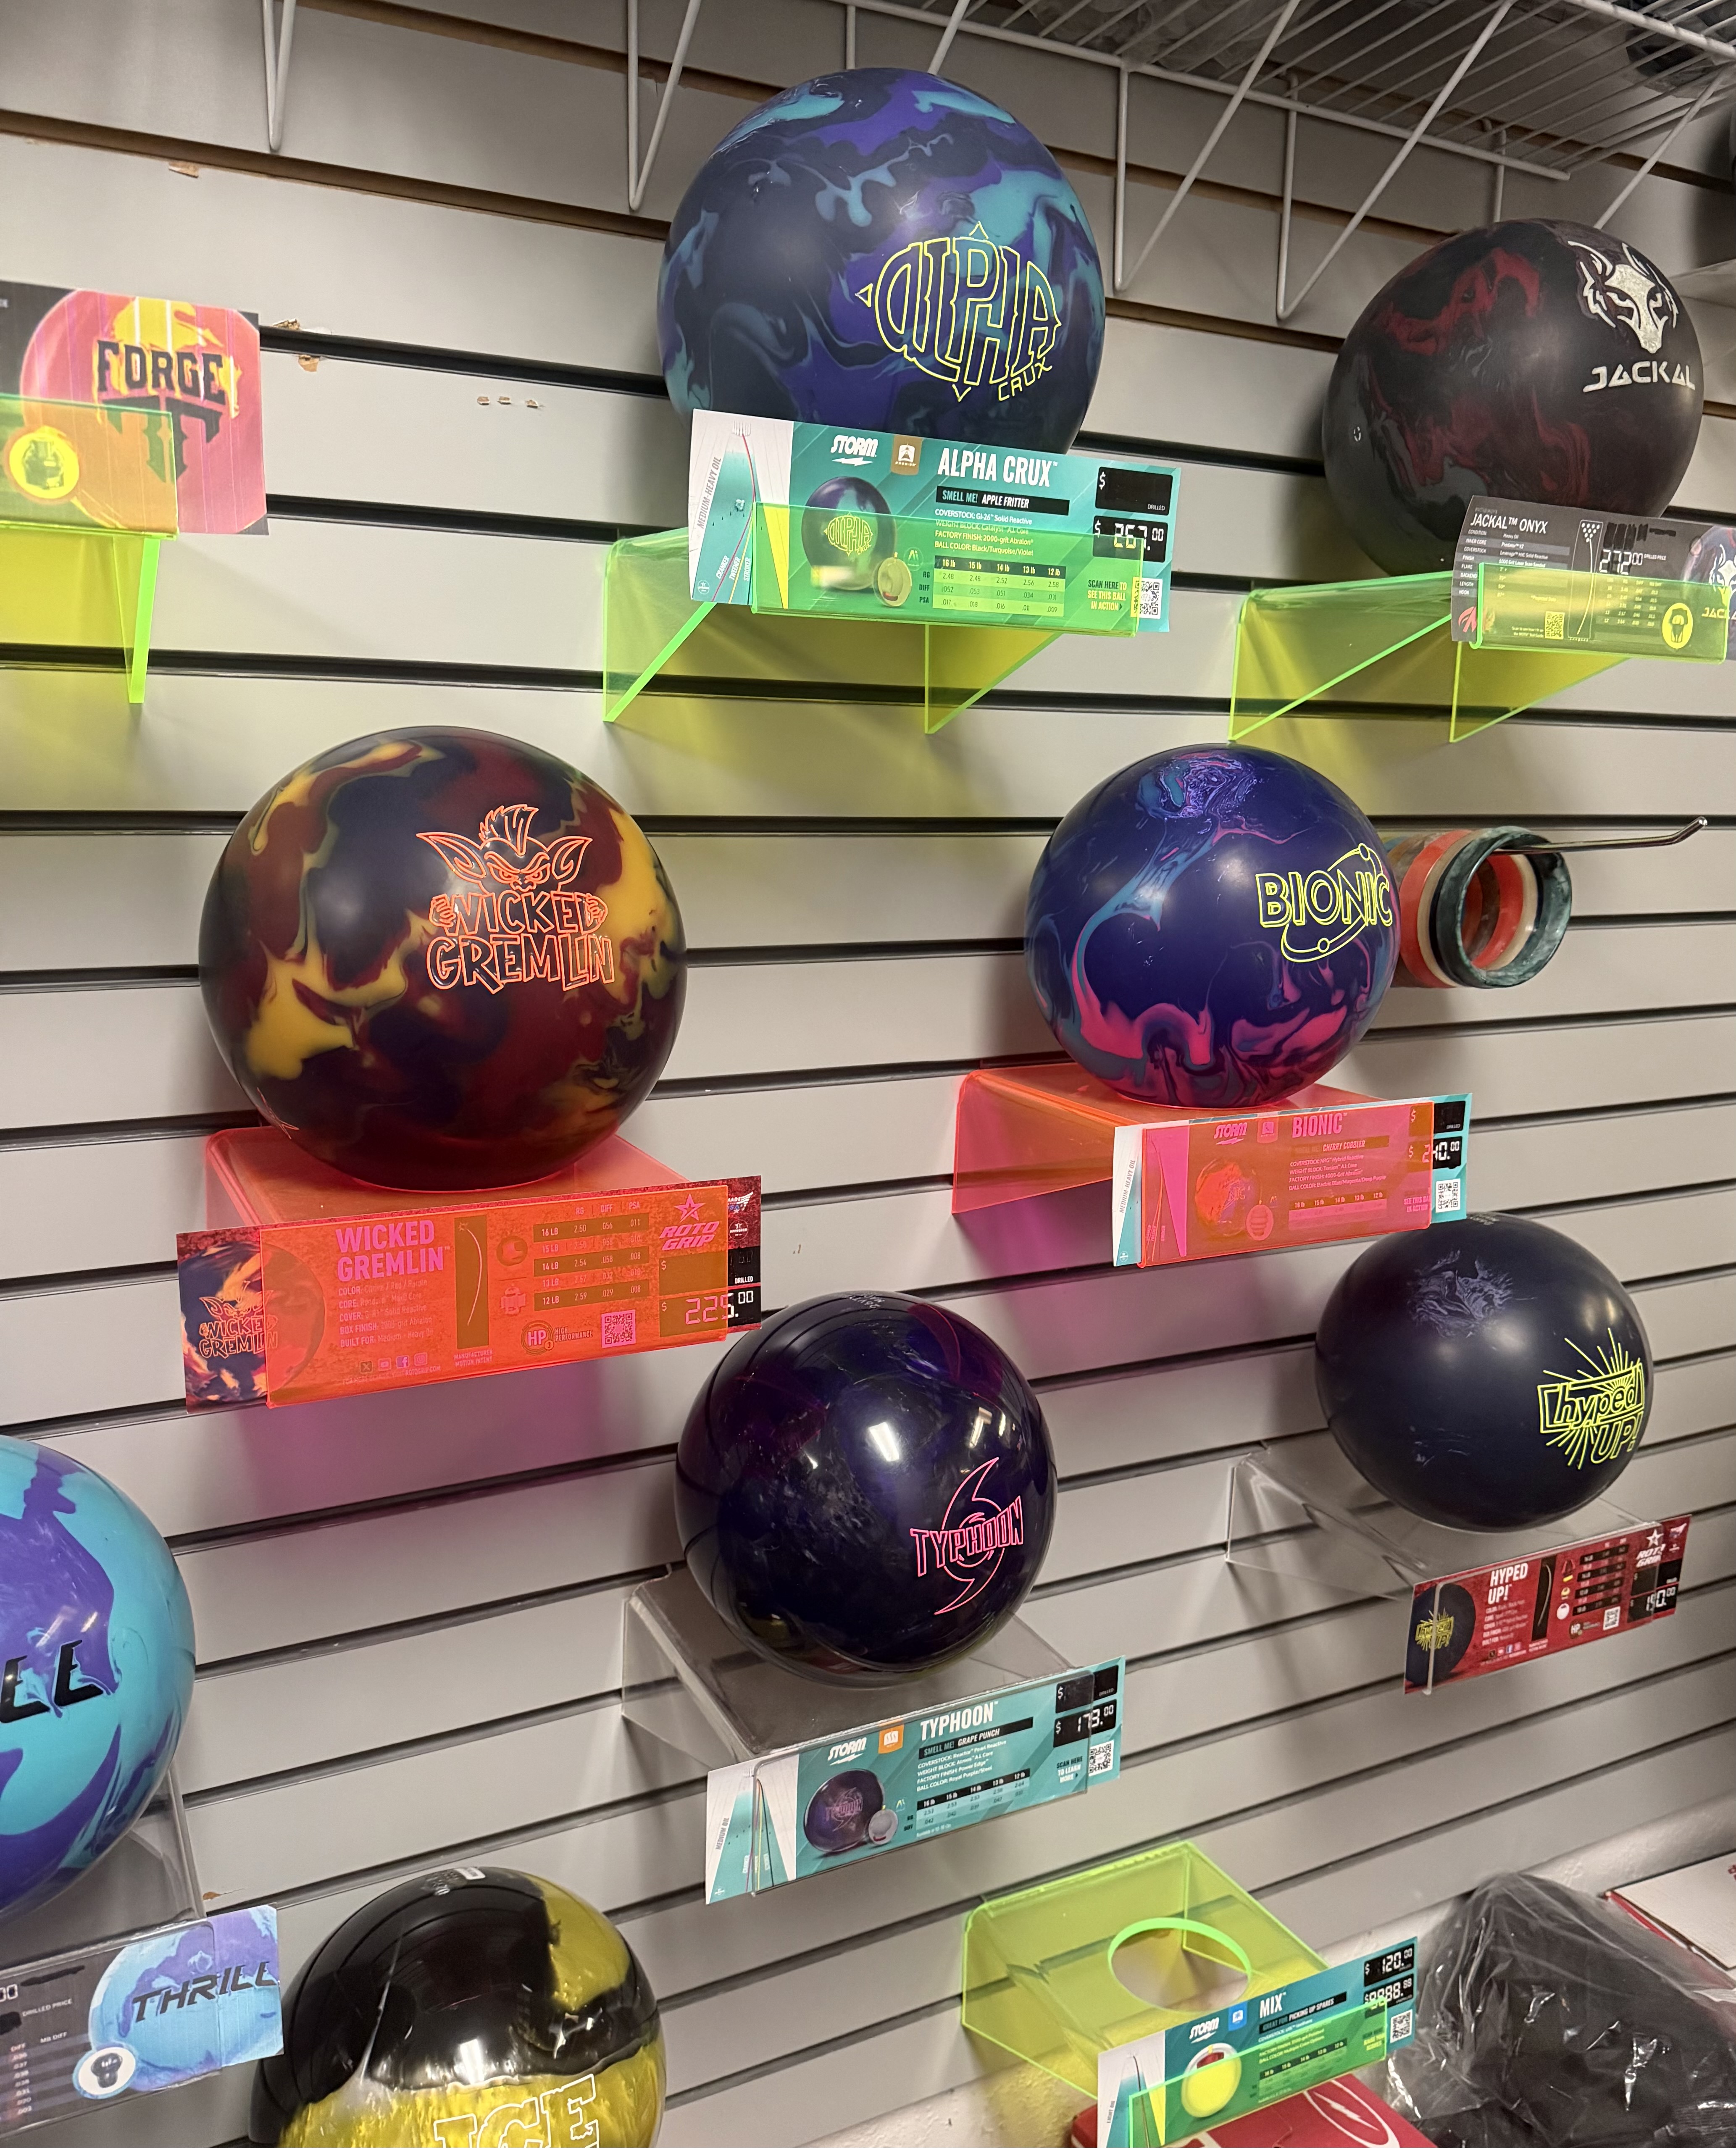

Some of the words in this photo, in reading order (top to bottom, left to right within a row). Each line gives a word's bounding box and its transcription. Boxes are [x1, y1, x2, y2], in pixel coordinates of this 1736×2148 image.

[875, 237, 1062, 385] ALPHA
[97, 339, 226, 406] FORGE
[998, 357, 1053, 401] CRUX
[1583, 360, 1696, 393] JACKAL
[830, 434, 879, 457] STORM
[937, 447, 997, 481] ALPHA
[1099, 471, 1105, 490] $
[697, 469, 719, 529] MEDIUM-HEAVY
[713, 457, 721, 474] OIL
[942, 490, 964, 502] SMELL
[966, 493, 978, 503] ME!
[982, 494, 1002, 506] APPLE
[1004, 496, 1029, 509] FRITTER
[935, 509, 975, 519] COVERSTOCK:
[1010, 516, 1032, 525] Reactive
[1094, 520, 1101, 538] $
[1519, 518, 1549, 534] ONYX
[935, 530, 962, 539] FACTORY
[963, 532, 982, 541] FINISH:
[983, 534, 1009, 544] 2000-grit
[934, 541, 948, 549] BALL
[950, 542, 971, 551] COLOR:
[972, 544, 1034, 556] Black/Turquoise/Violet
[950, 559, 956, 568] lb
[976, 562, 982, 570] lb
[1088, 579, 1103, 588] SCAN
[1119, 582, 1127, 590] TO
[1087, 590, 1097, 599] SEE
[1099, 591, 1112, 600] THIS
[1113, 592, 1126, 601] BALL
[1098, 602, 1119, 611] ACTION
[1255, 868, 1393, 928] BIONIC
[429, 889, 608, 937] WICKED
[426, 933, 615, 994] GREMLIN
[1410, 1109, 1416, 1123] $
[1213, 1122, 1248, 1139] STORM
[1323, 1142, 1342, 1152] CHERRY
[1343, 1140, 1366, 1149] COBBLER
[1408, 1145, 1413, 1159] $
[1119, 1169, 1134, 1213] MEDIUM-HEAVY
[600, 1204, 613, 1213] DIFF
[336, 1220, 434, 1253] WICKED
[551, 1227, 558, 1236] LB
[659, 1221, 720, 1239] ROTO
[551, 1244, 558, 1252] LB
[662, 1234, 715, 1251] GRIP
[551, 1261, 559, 1270] LB
[661, 1260, 667, 1270] $
[734, 1276, 753, 1284] DRILLED
[551, 1278, 559, 1286] LB
[543, 1297, 550, 1305] 12
[551, 1295, 559, 1304] LB
[661, 1301, 667, 1312] $
[528, 1329, 547, 1346] HP
[555, 1326, 568, 1335] HIGH
[555, 1330, 593, 1342] PERFORMANCE
[1553, 1365, 1638, 1430] hyped
[1590, 1411, 1644, 1464] UP!
[910, 1495, 1024, 1577] TYPHOON
[1489, 1562, 1528, 1587] HYPED
[1057, 1686, 1063, 1700] $
[1099, 1688, 1114, 1696] DRILLED
[1055, 1721, 1061, 1735] $
[827, 1737, 867, 1762] STORM
[924, 1745, 942, 1756] SMELL
[944, 1741, 955, 1751] ME!
[958, 1734, 978, 1746] GRAPE
[979, 1728, 1000, 1740] PUNCH
[1057, 1760, 1069, 1769] SCAN
[917, 1775, 940, 1784] FACTORY
[715, 1827, 726, 1850] MEDIUM
[1365, 1963, 1370, 1975] $
[132, 1961, 278, 2023] THRILL
[22, 2003, 51, 2017] DRILLED
[52, 1998, 73, 2009] PRICE
[1289, 2007, 1308, 2022] PICKING
[1309, 2005, 1315, 2013] UP
[1316, 1998, 1334, 2011] SPARES
[1189, 2017, 1220, 2039] STORM
